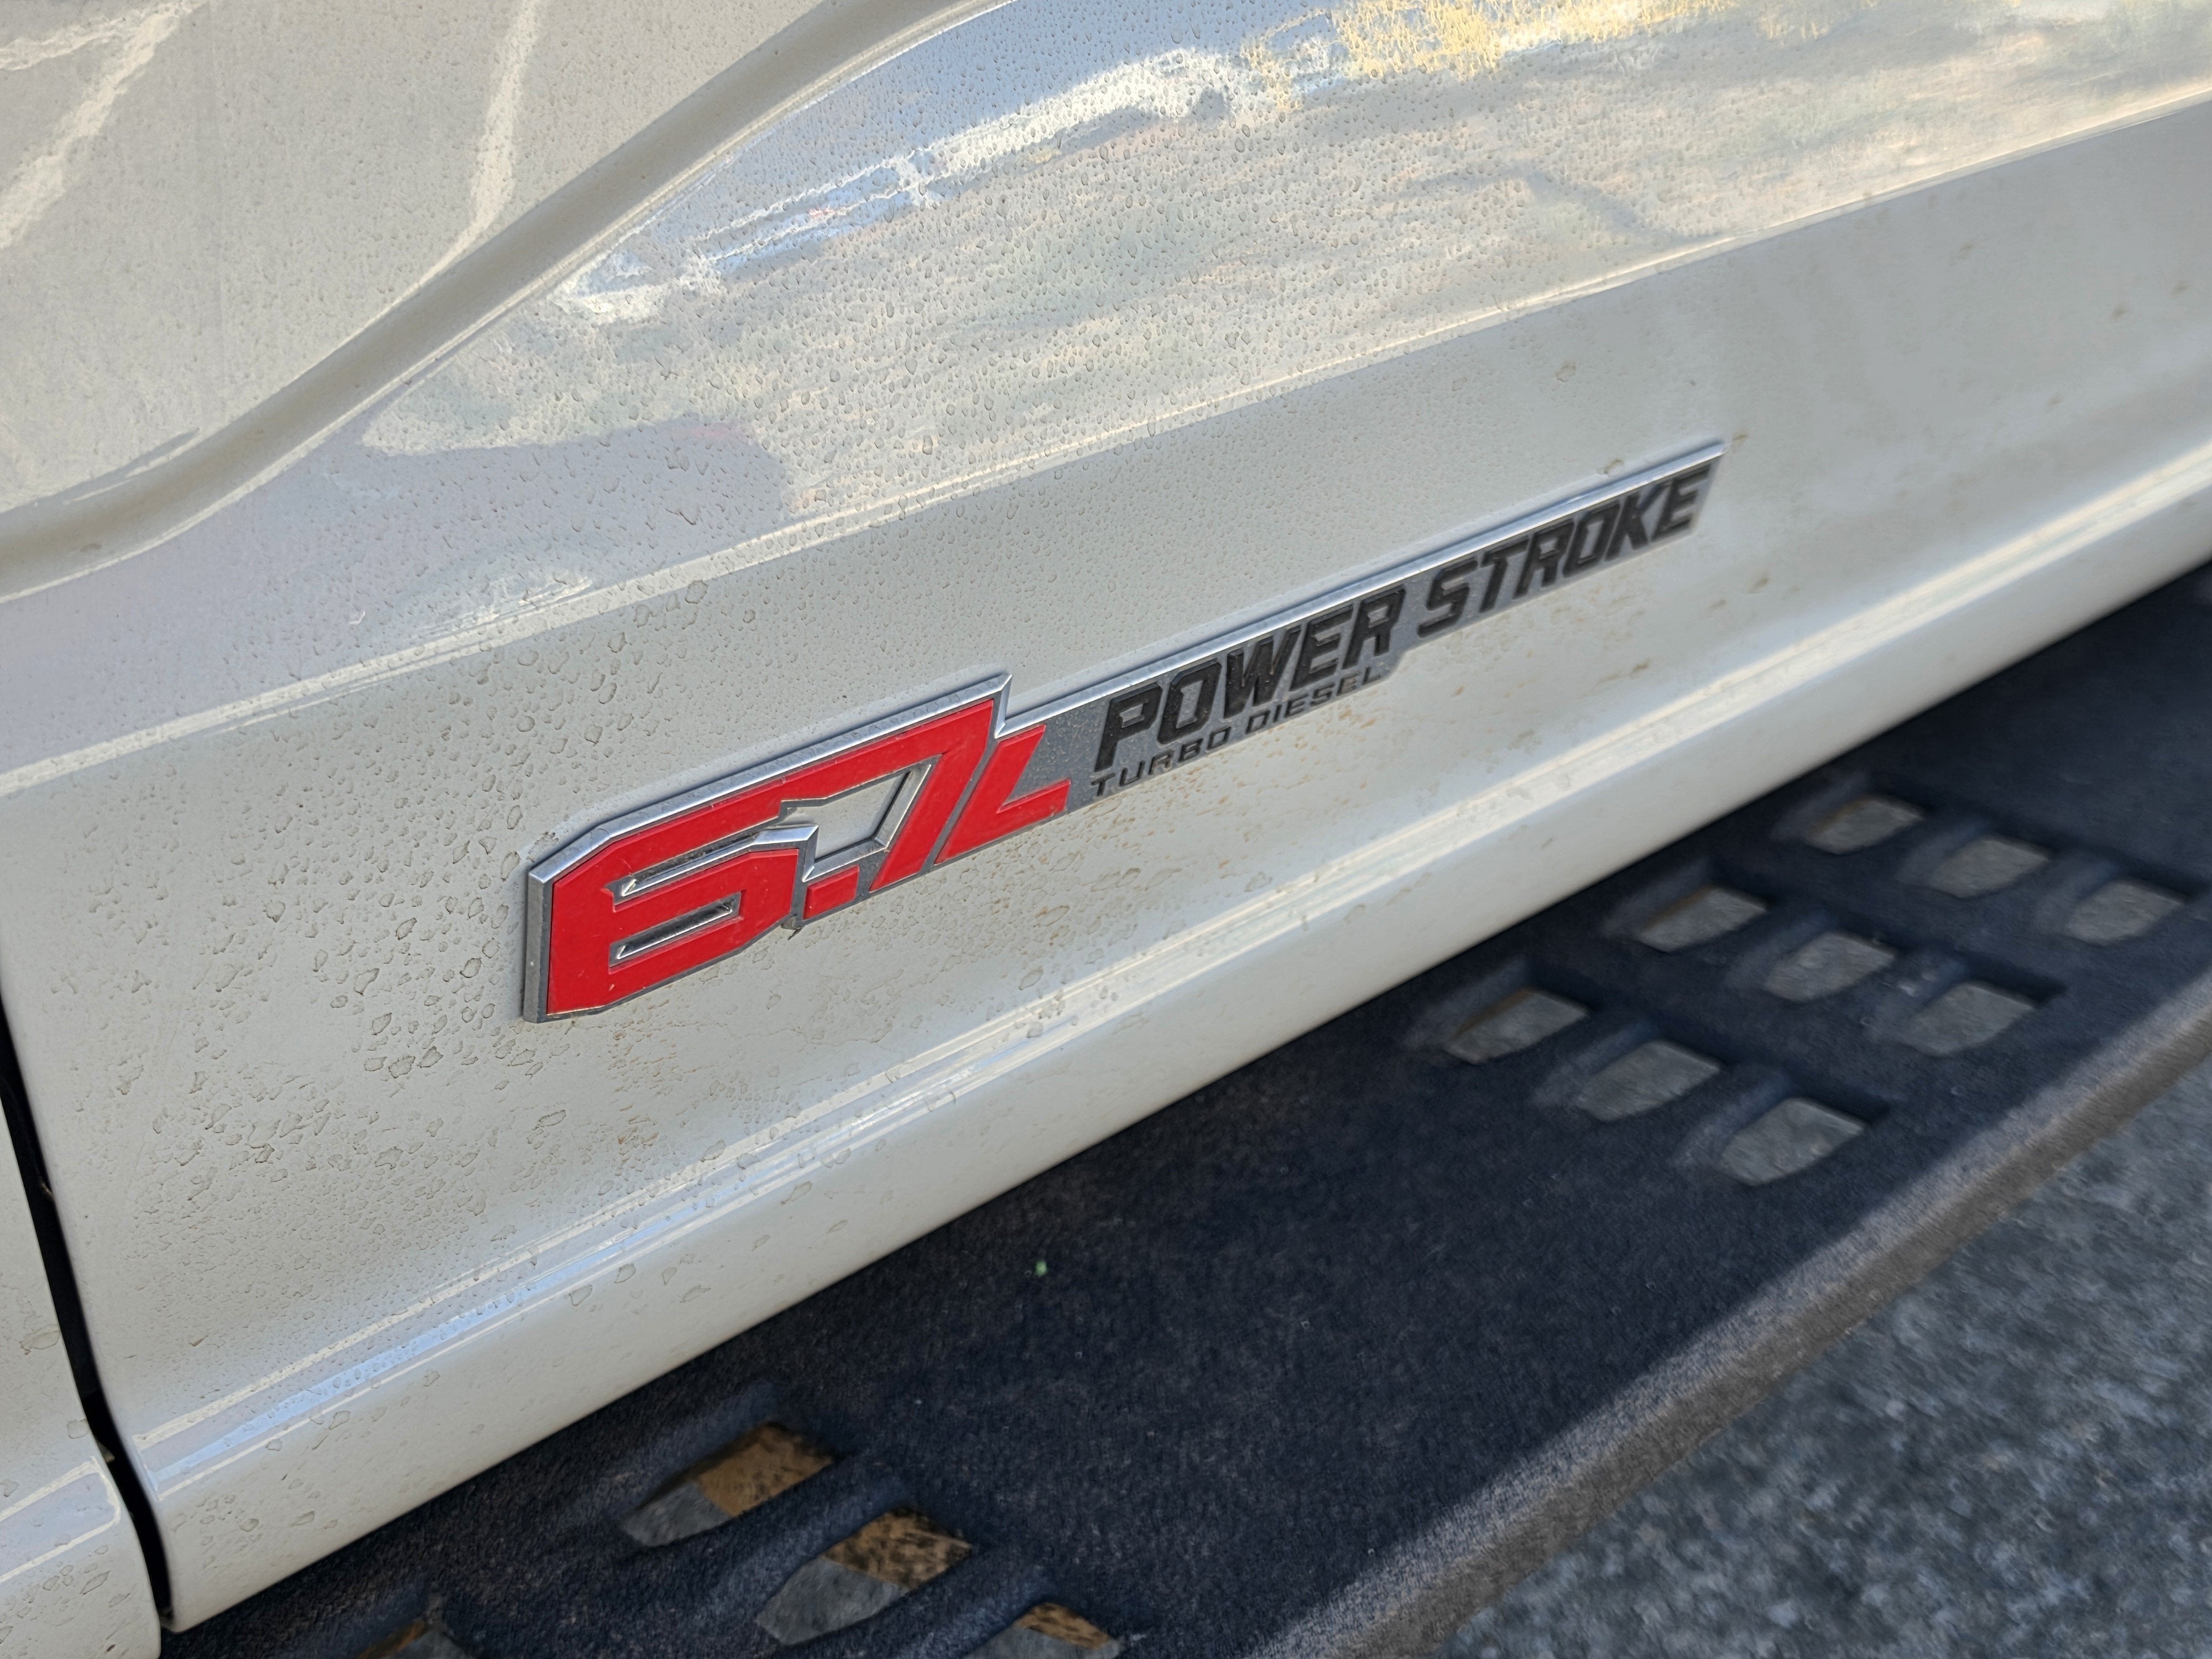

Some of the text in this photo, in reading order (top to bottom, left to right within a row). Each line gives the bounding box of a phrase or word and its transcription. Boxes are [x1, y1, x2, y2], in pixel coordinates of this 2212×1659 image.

[1092, 667, 1381, 796] TURBO DIESEL
[1095, 464, 1710, 772] POWER STROKE
[546, 698, 1071, 1015] 6.7L
